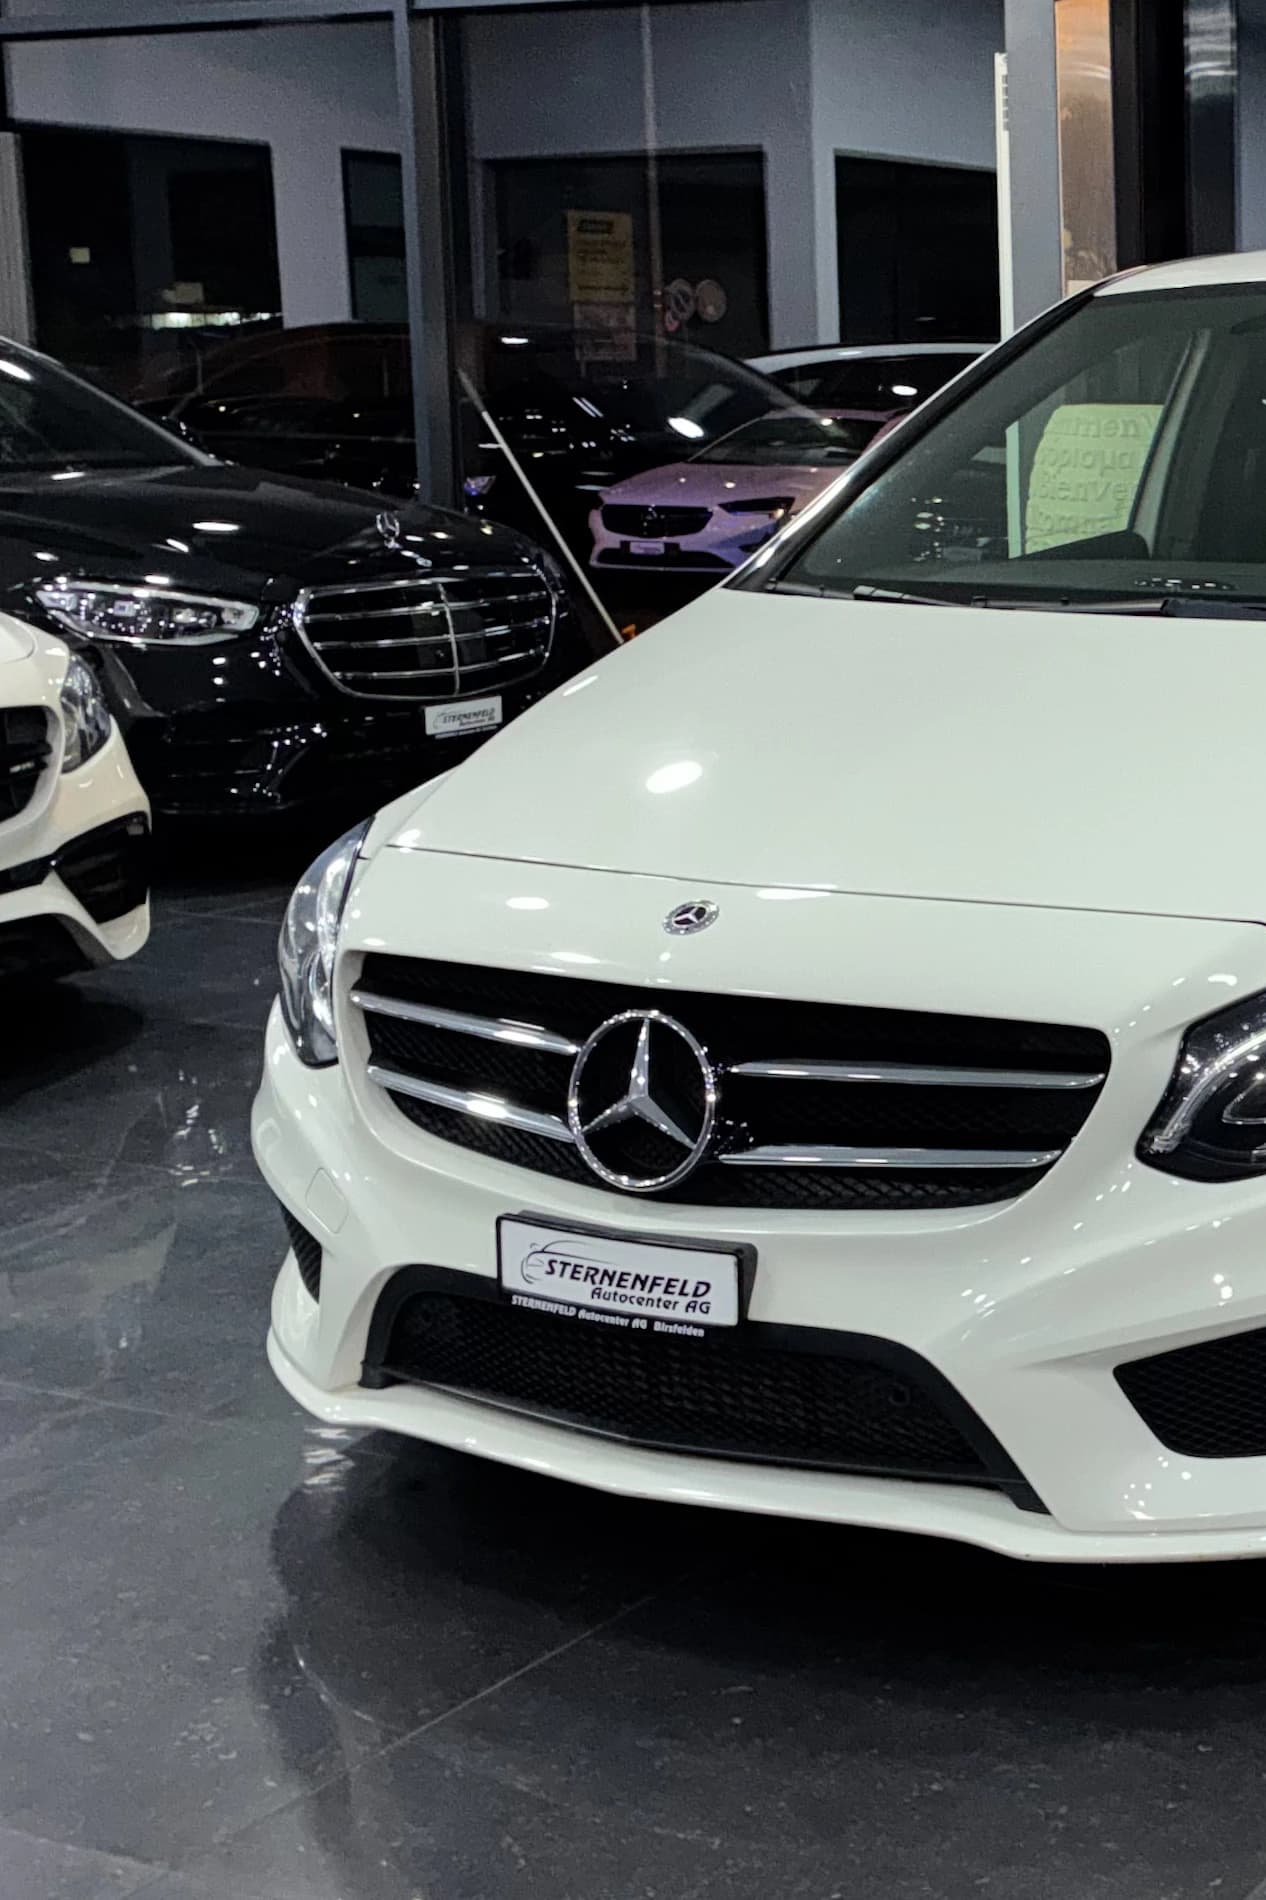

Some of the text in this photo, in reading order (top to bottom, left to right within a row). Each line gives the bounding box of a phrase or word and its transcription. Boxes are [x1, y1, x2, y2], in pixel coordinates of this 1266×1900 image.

[545, 1259, 712, 1298] STERNENFELD
[511, 1294, 705, 1338] STERNENFELD Autocenter AG Birsfelden
[591, 1287, 712, 1315] Autocenter AG
